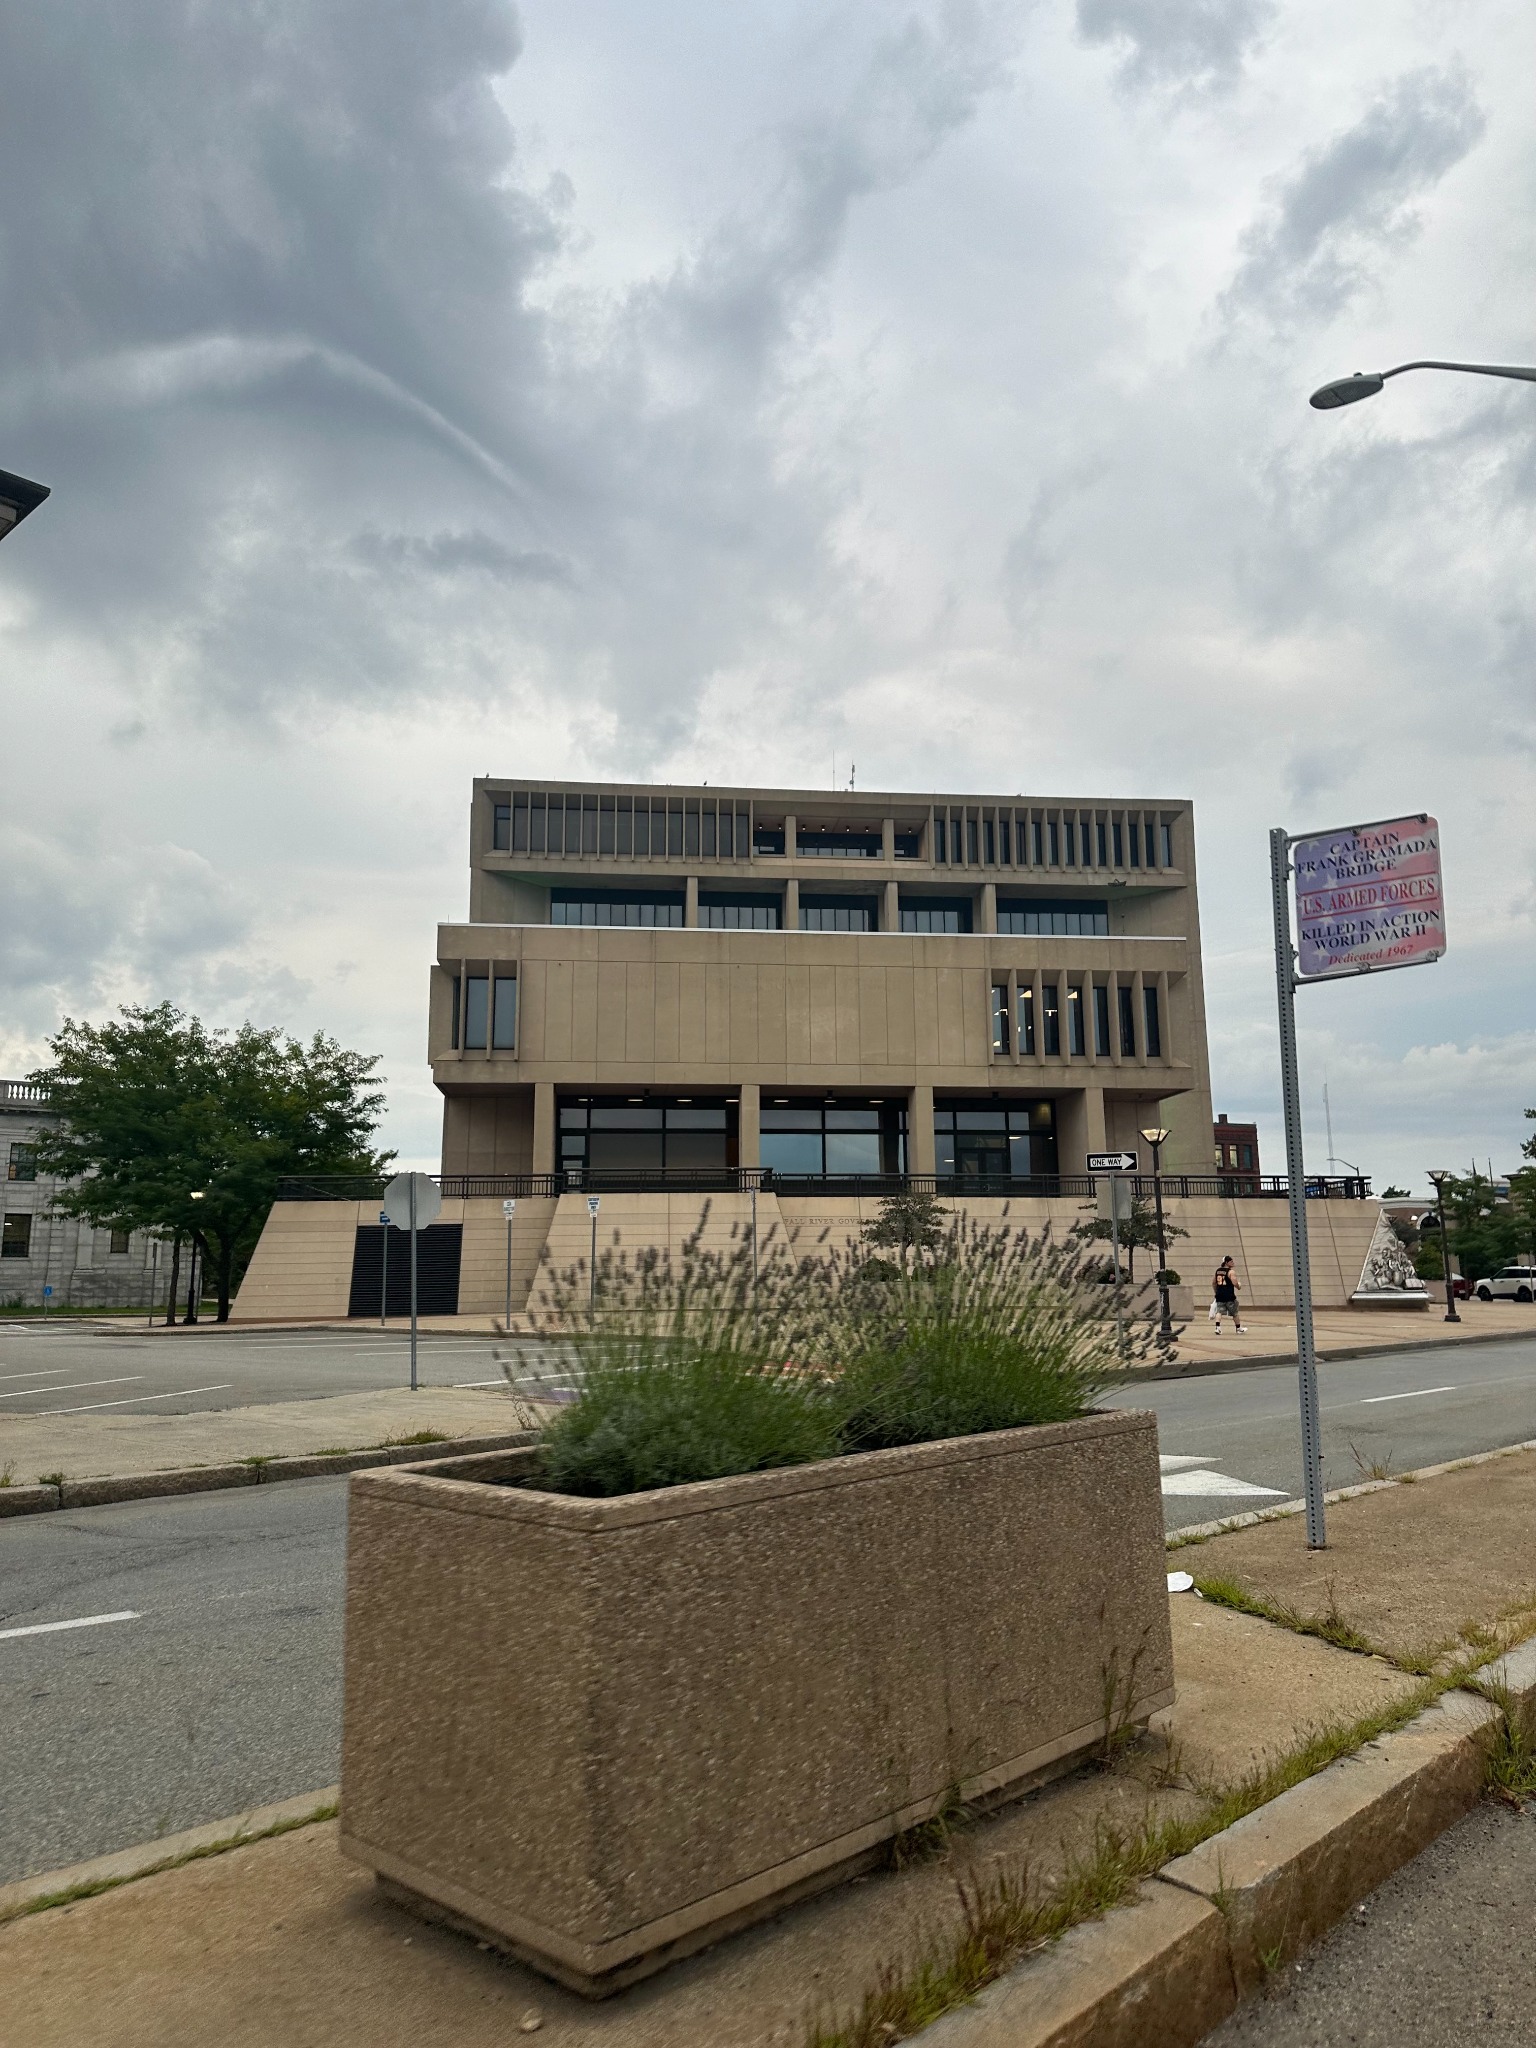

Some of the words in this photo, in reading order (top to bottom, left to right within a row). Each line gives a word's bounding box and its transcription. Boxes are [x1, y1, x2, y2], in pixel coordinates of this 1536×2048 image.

[1297, 855, 1349, 874] FRANK
[1353, 838, 1437, 863] GRAMADA
[1330, 832, 1399, 855] CAPTAIN
[1336, 858, 1397, 880] BRIDGE
[1303, 896, 1326, 915] U.S.
[1329, 886, 1377, 912] ARMED
[1381, 877, 1435, 902] FORCES
[1302, 921, 1356, 941] KILLED
[1360, 918, 1376, 932] IN
[1380, 909, 1440, 929] ACTION
[1314, 931, 1370, 951] WORLD
[1375, 927, 1411, 943] WAR
[1416, 924, 1426, 936] II
[1328, 949, 1383, 965] Dedicated
[1386, 944, 1413, 958] 1967
